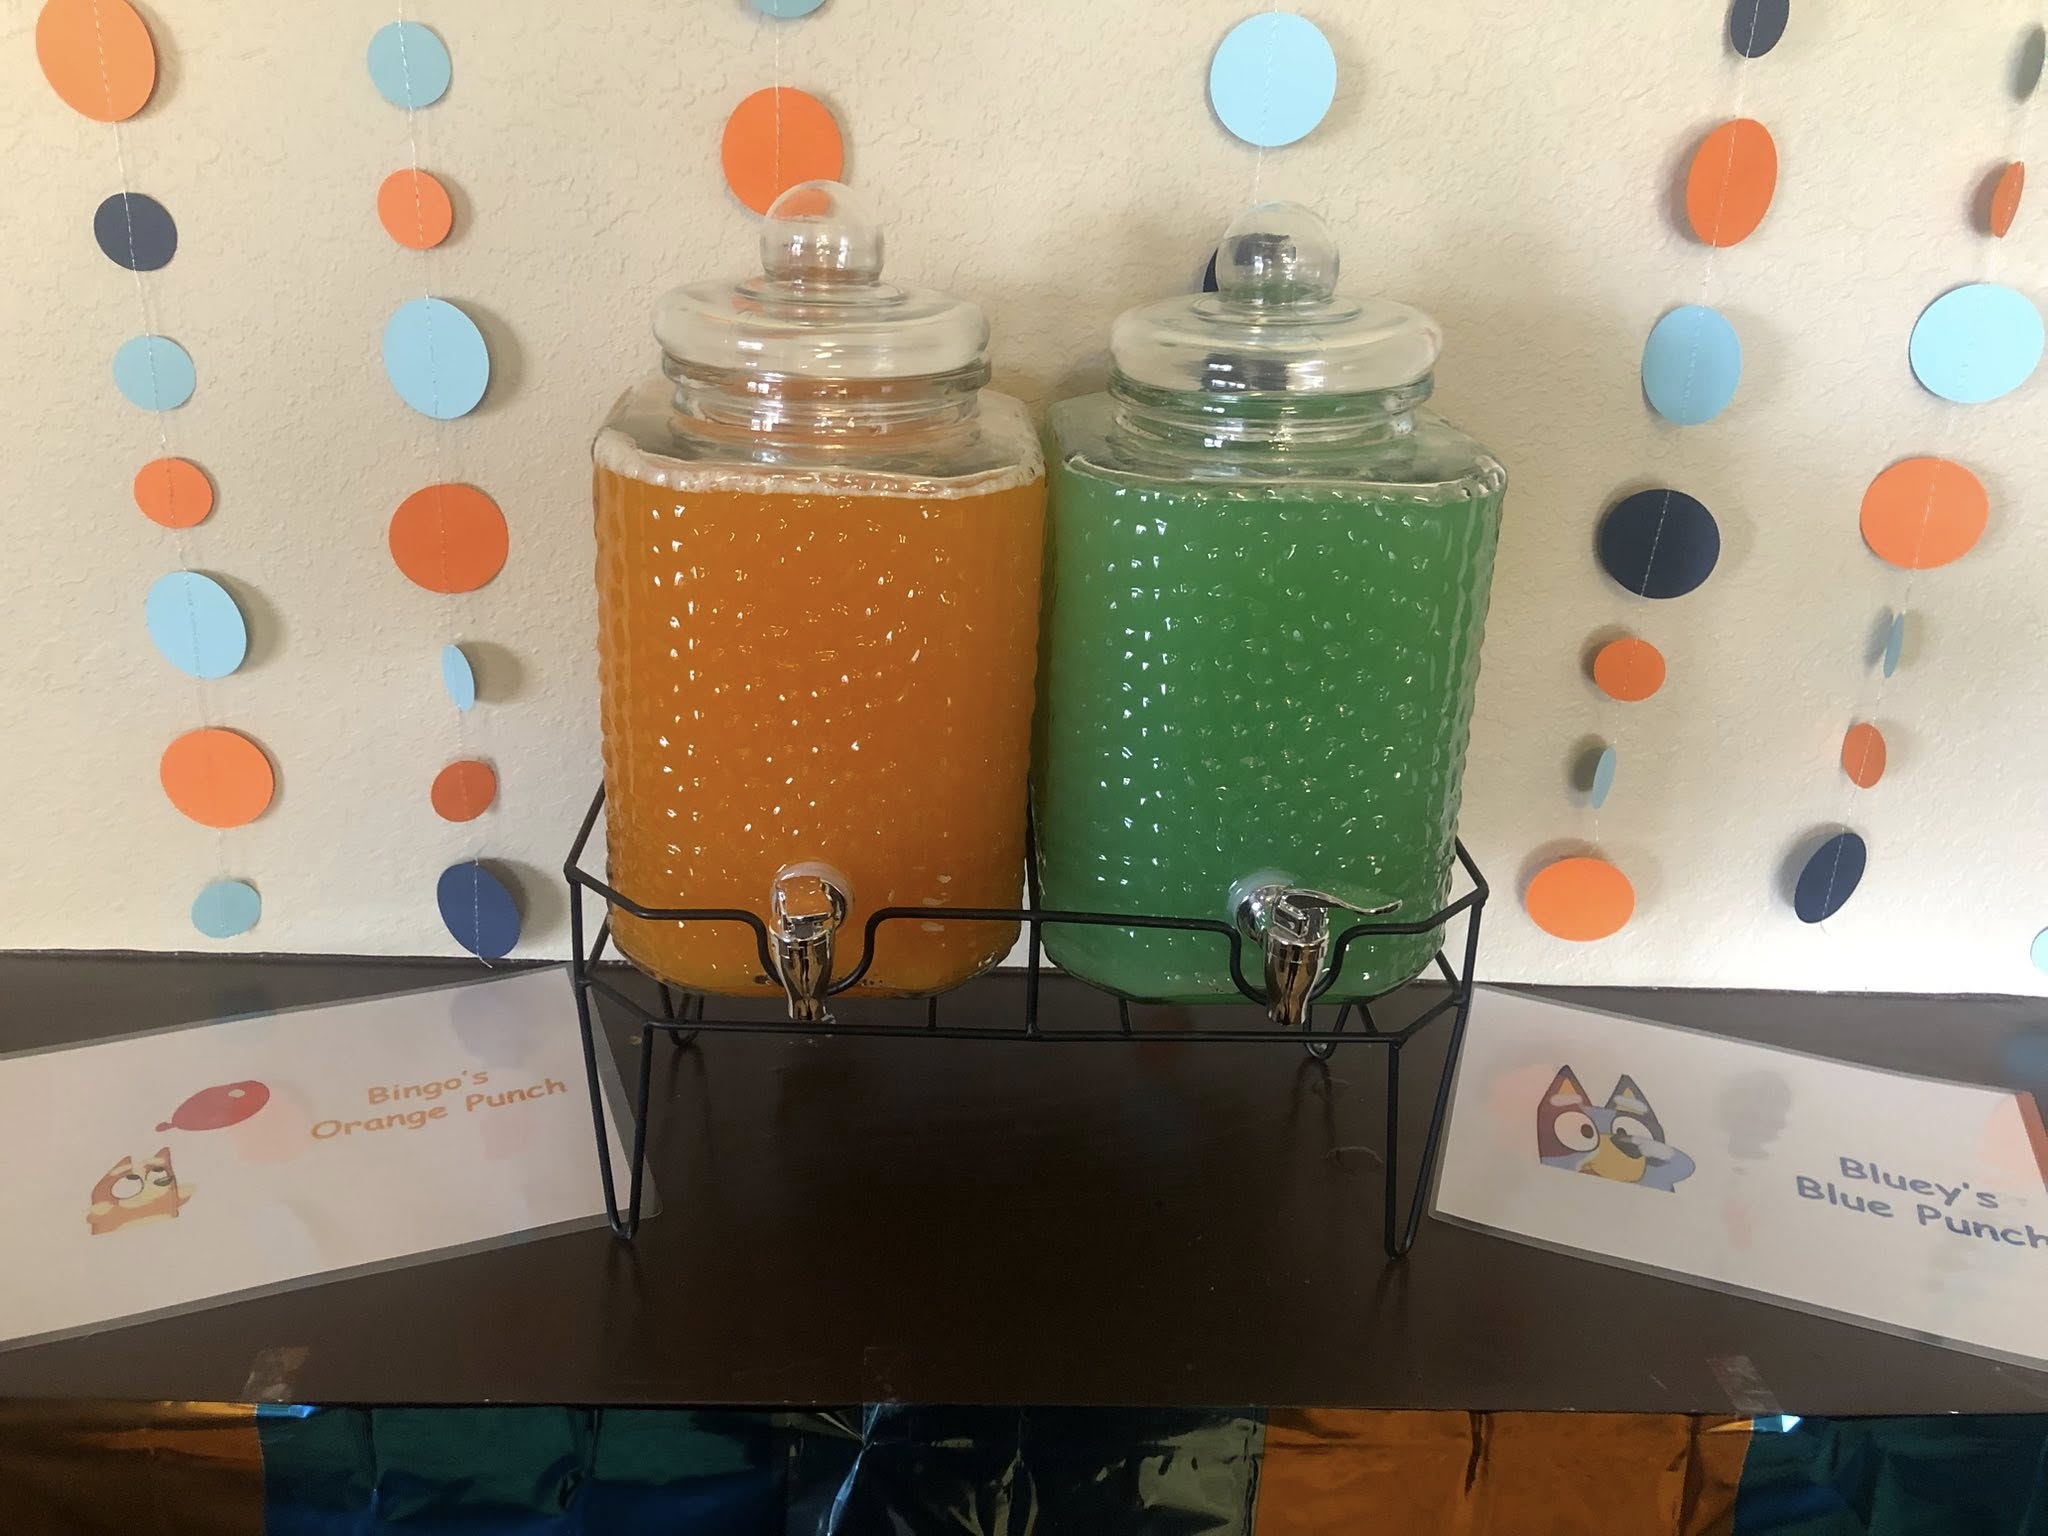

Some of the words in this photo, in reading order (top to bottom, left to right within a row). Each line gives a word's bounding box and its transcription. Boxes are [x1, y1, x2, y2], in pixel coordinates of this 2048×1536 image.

[310, 1105, 449, 1140] Orange
[465, 1078, 568, 1112] Punch
[367, 1070, 489, 1105] Bingo's
[1796, 1175, 1895, 1219] Blue
[1839, 1156, 1999, 1209] Bluey's
